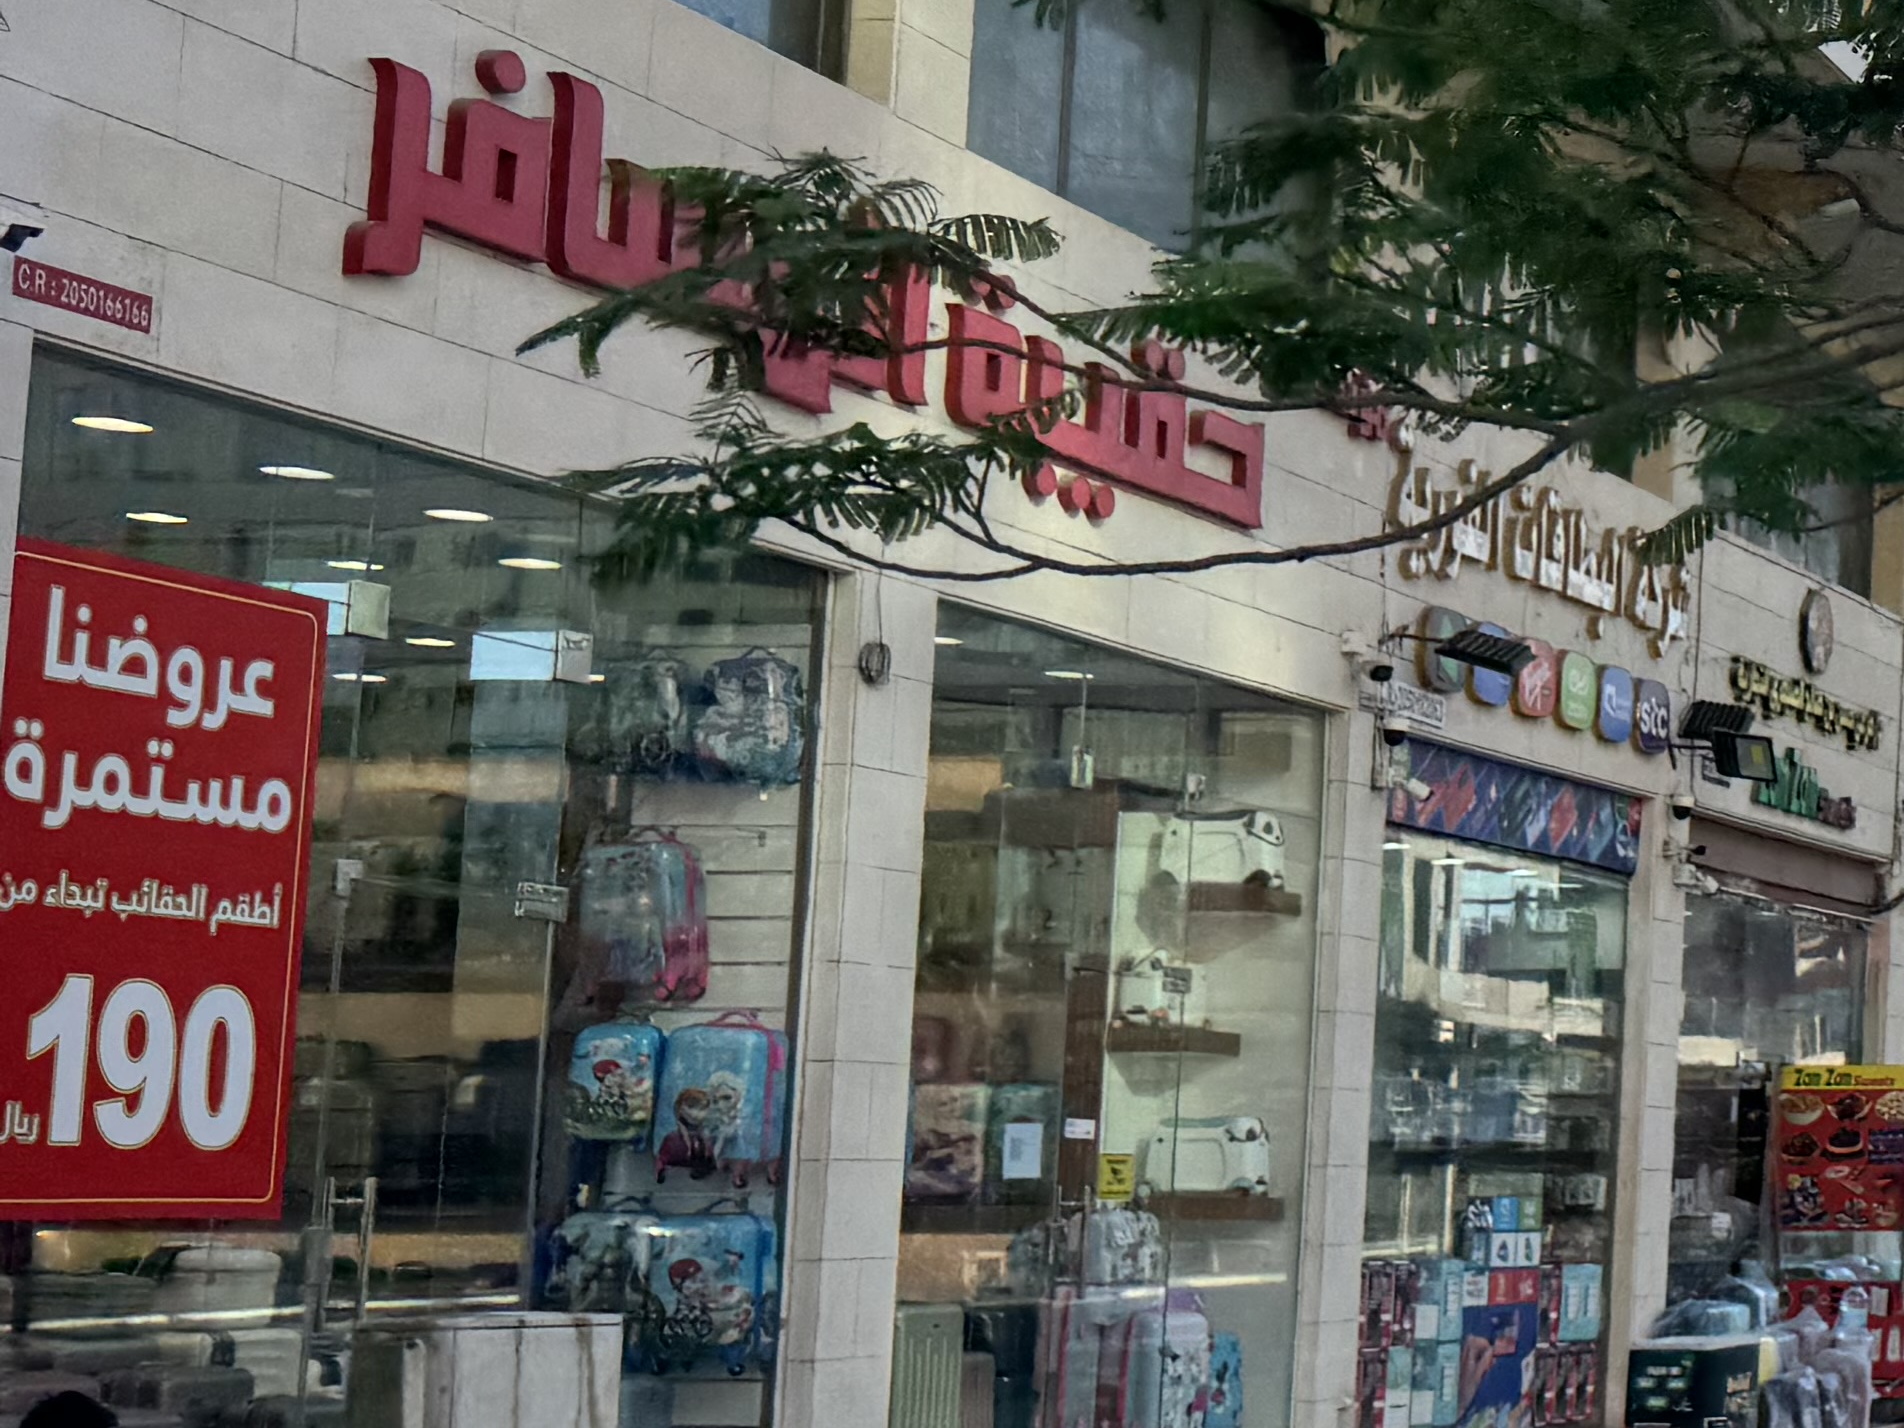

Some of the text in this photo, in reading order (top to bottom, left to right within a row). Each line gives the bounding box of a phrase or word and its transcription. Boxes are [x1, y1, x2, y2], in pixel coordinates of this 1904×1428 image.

[60, 277, 149, 327] 2050166166
[43, 584, 275, 732] عروضنا
[1640, 698, 1669, 740] stc
[4, 717, 293, 833] مستمرة
[0, 872, 38, 911] من
[111, 878, 208, 922] الحقائب
[26, 973, 257, 1152] 190
[0, 1100, 41, 1145] ريال
